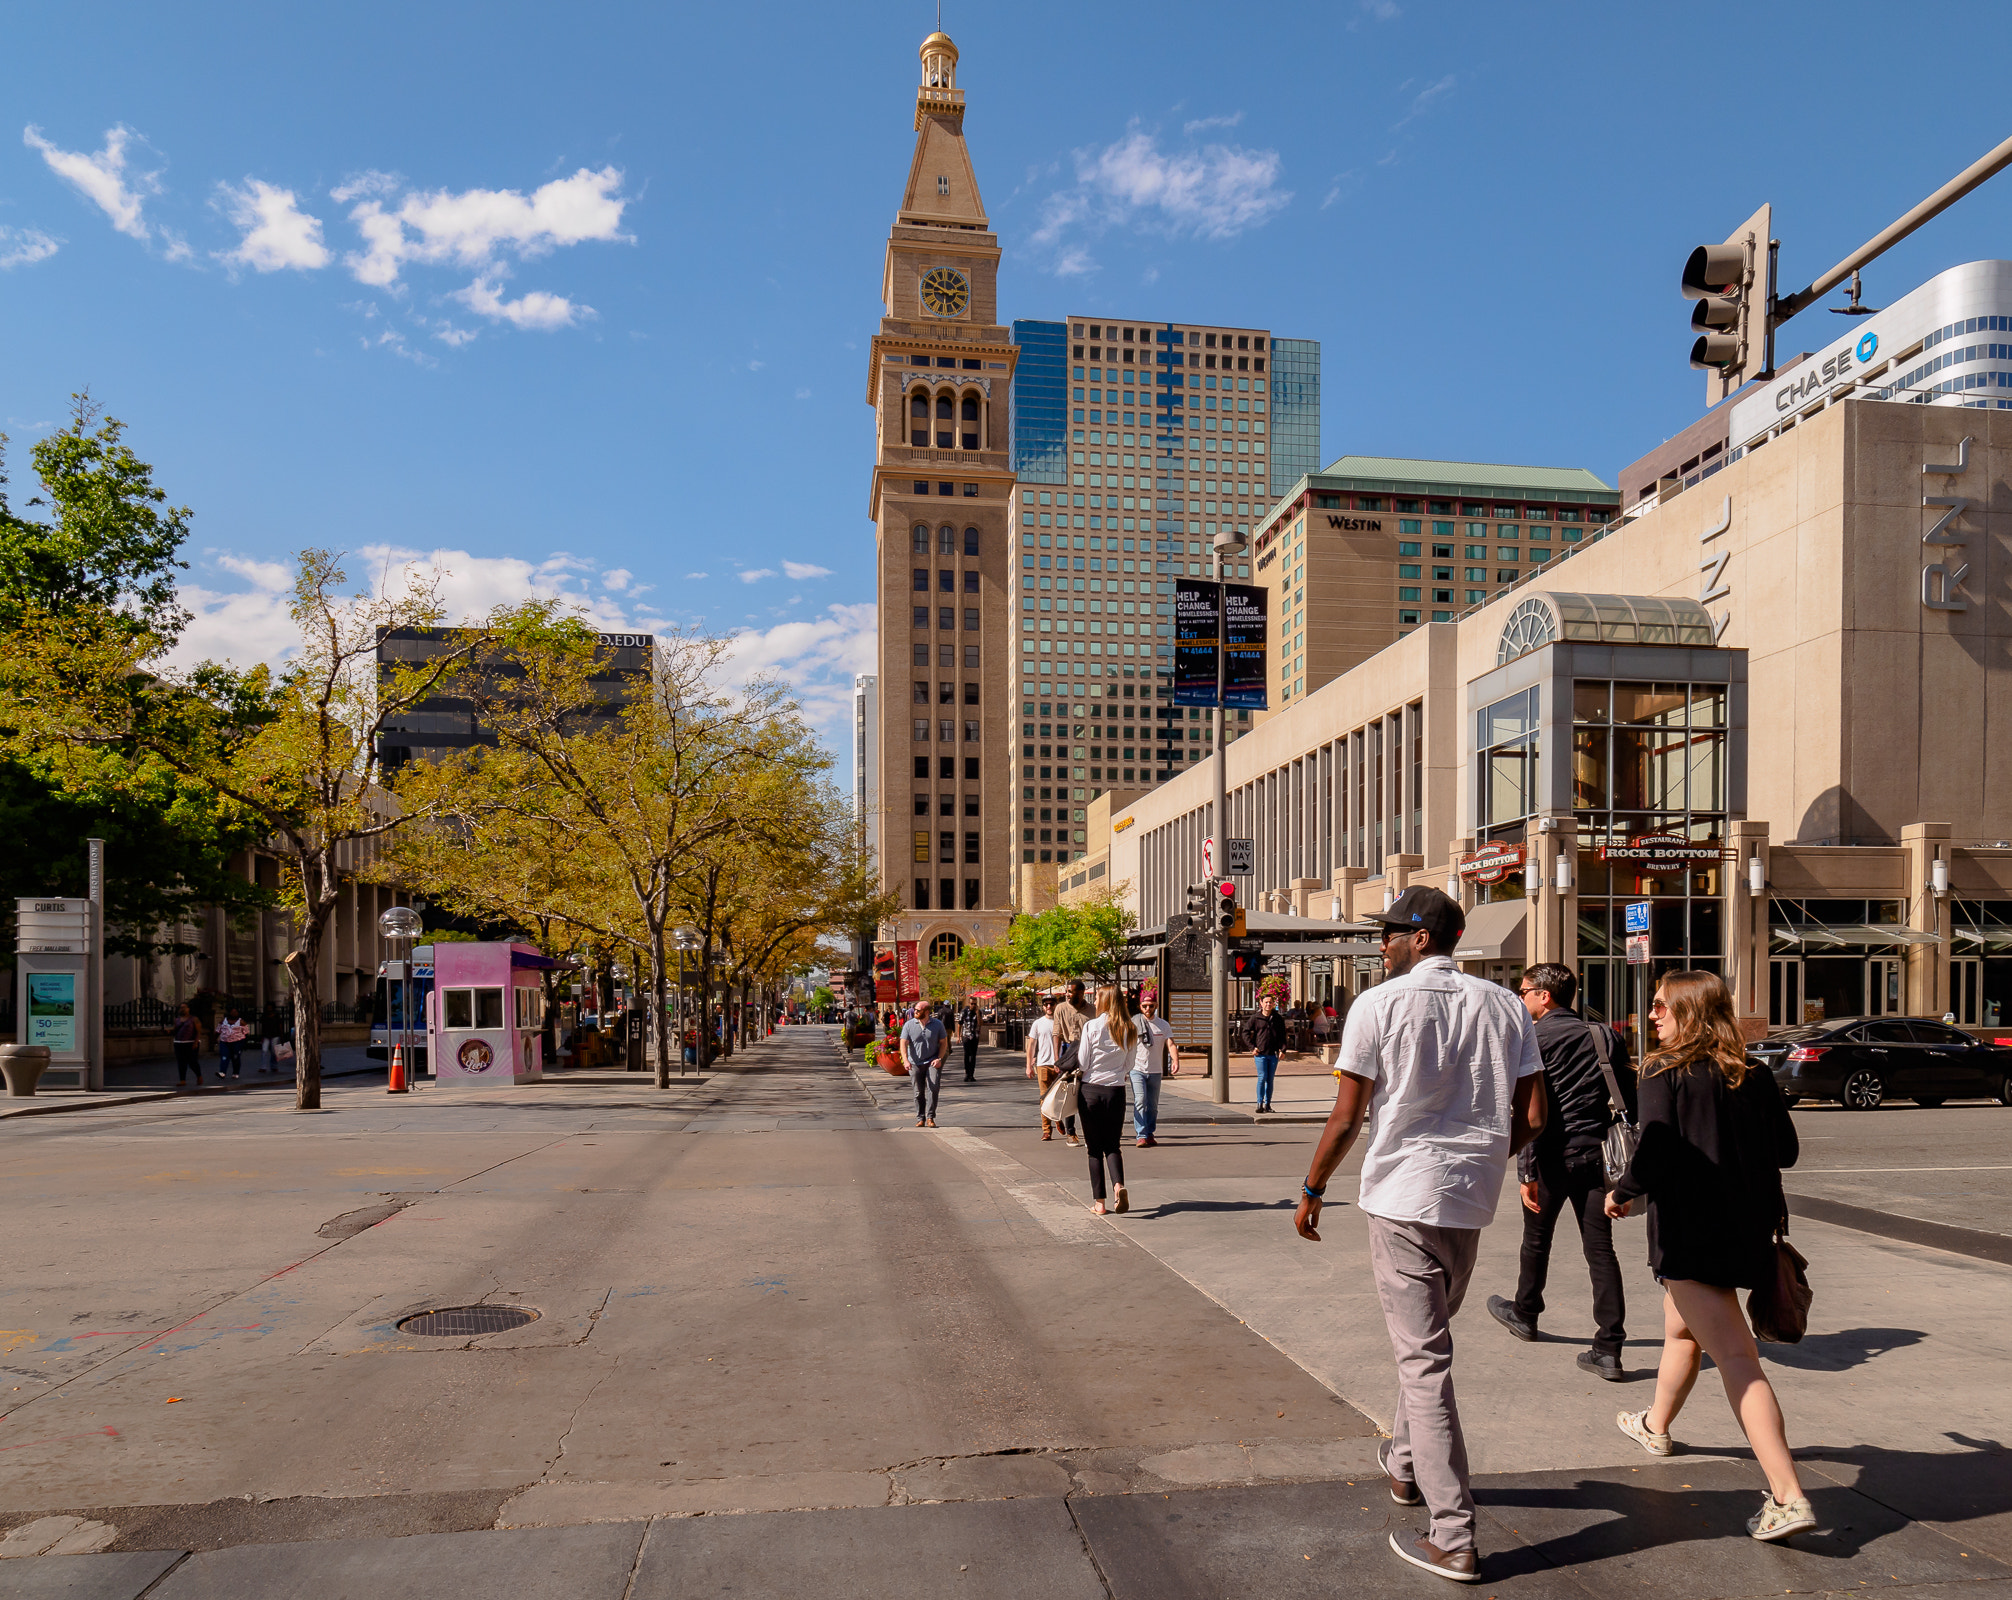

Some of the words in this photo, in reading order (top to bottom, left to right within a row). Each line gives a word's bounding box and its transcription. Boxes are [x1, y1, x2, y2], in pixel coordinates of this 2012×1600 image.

[1776, 347, 1852, 411] CHASE
[1327, 515, 1381, 531] WESTIN
[1922, 436, 1970, 610] RNL
[1176, 591, 1200, 602] HELP
[1225, 596, 1249, 606] HELP
[1177, 602, 1211, 610] CHANGE
[1226, 607, 1259, 615] CHANGE
[597, 634, 646, 647] D.EDU
[1231, 842, 1251, 850] ONE
[1640, 836, 1687, 846] RESTAURANT
[1231, 852, 1251, 860] WAY
[1606, 848, 1652, 858] ROCK
[1654, 848, 1720, 858] BOTTOM
[1460, 860, 1481, 872] ROCK
[1482, 853, 1519, 868] BOTTOM
[1646, 862, 1681, 871] BREWERY
[91, 846, 99, 898] INFORMATION
[35, 903, 66, 912] CURTIS
[899, 946, 910, 995] AWKWARD
